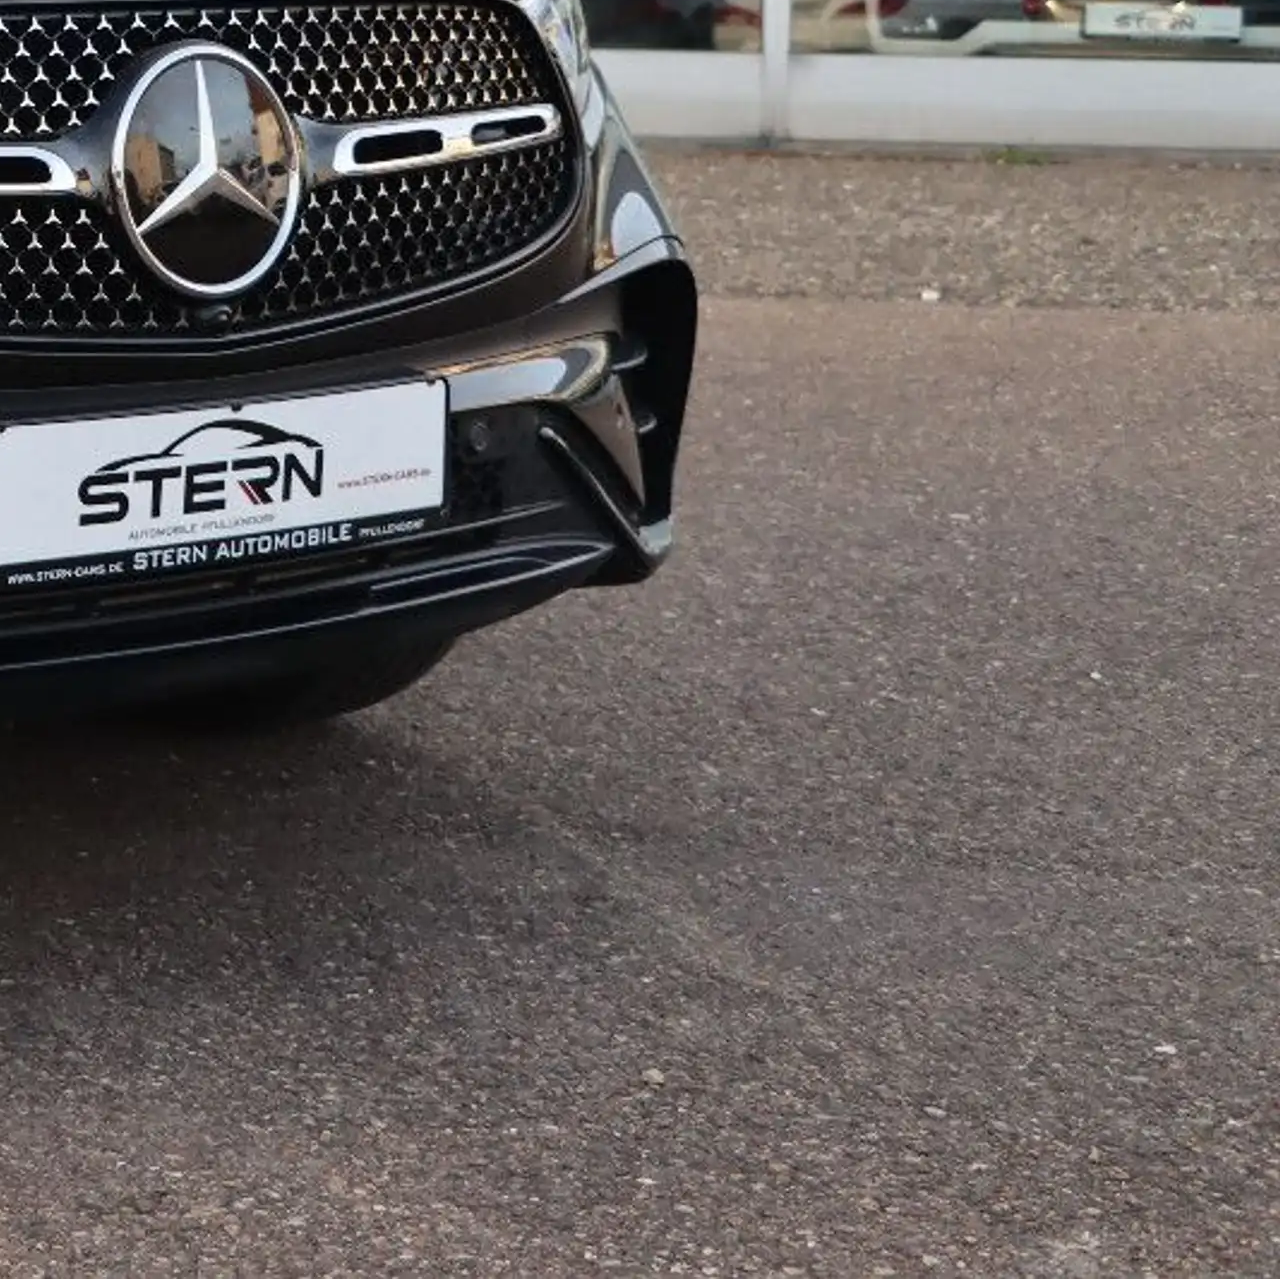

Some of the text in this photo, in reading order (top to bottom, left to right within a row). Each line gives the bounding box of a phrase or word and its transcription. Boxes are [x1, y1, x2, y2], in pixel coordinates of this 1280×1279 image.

[78, 448, 324, 527] STERN
[132, 544, 208, 571] STERN
[214, 523, 352, 560] AUTOMOBILE
